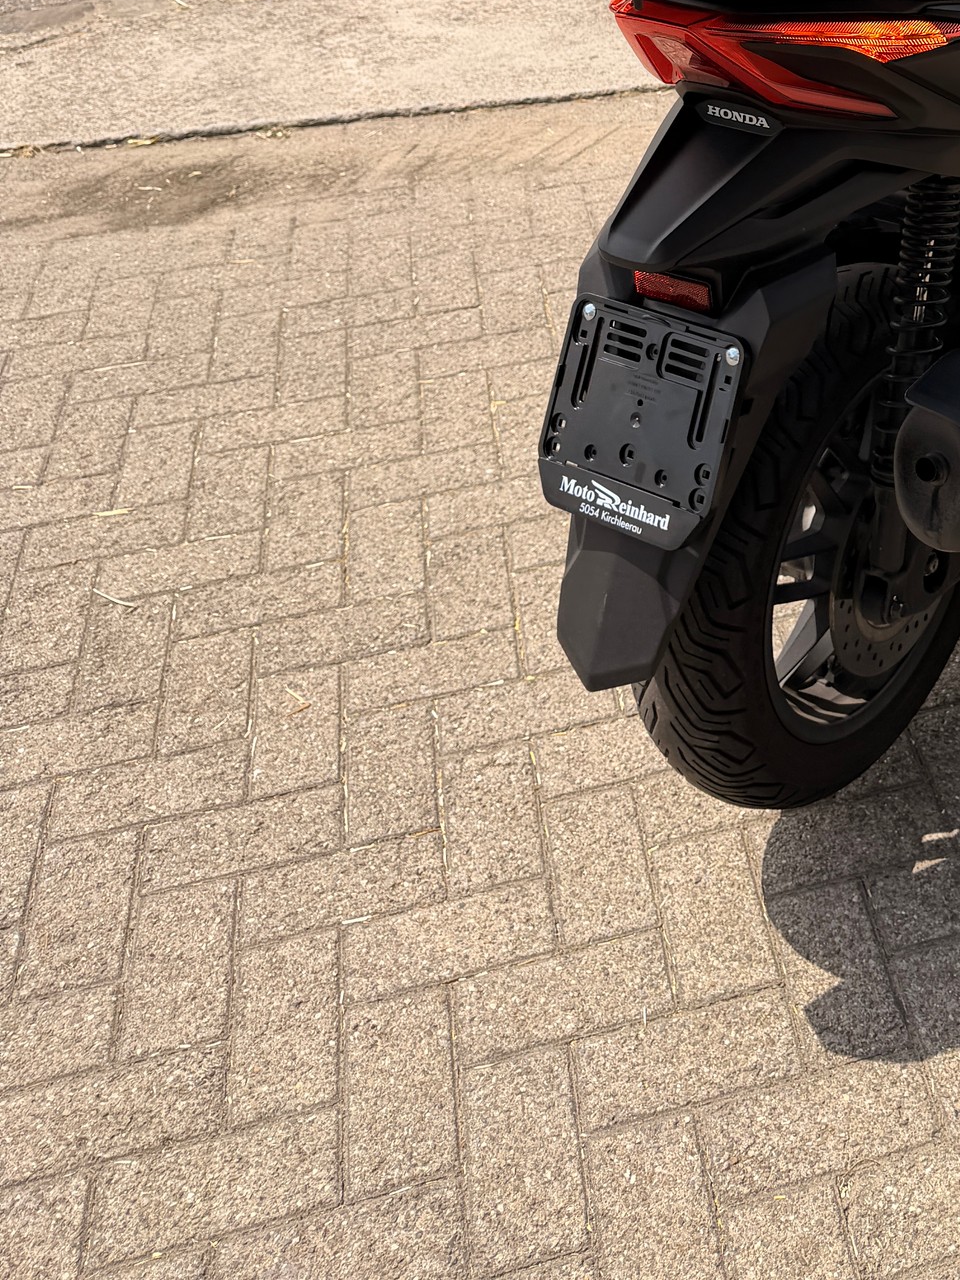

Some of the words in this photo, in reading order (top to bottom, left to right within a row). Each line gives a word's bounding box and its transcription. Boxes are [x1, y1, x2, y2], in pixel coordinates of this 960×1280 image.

[707, 104, 770, 129] HONDA
[559, 475, 596, 502] Moto
[591, 479, 671, 531] Reinhard
[579, 502, 600, 519] 5054
[600, 510, 643, 535] Kirchleerau
